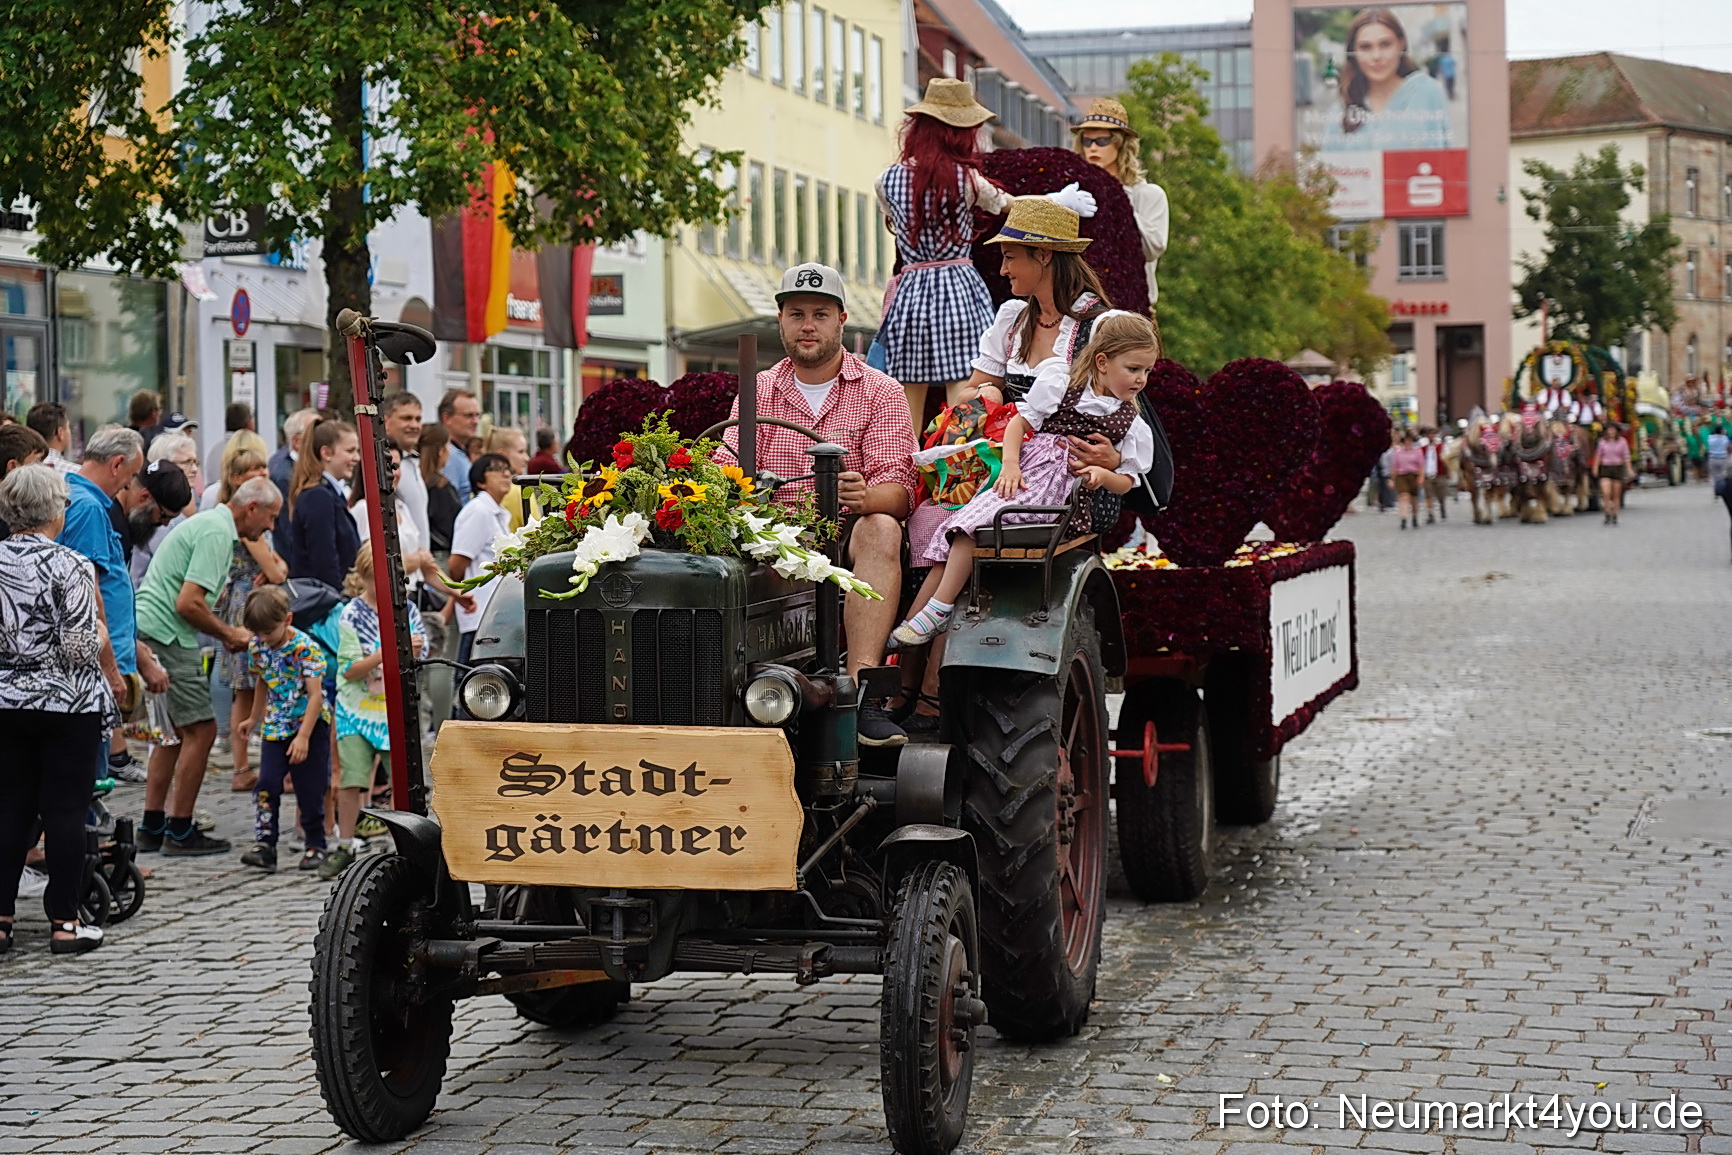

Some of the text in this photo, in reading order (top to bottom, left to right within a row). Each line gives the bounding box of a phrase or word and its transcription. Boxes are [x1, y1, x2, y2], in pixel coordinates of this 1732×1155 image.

[207, 207, 250, 238] CB
[757, 610, 816, 653] HANOMA
[1303, 612, 1308, 668] i
[1309, 608, 1318, 664] di
[497, 751, 733, 797] Stadt-
[484, 813, 748, 862] gärtner
